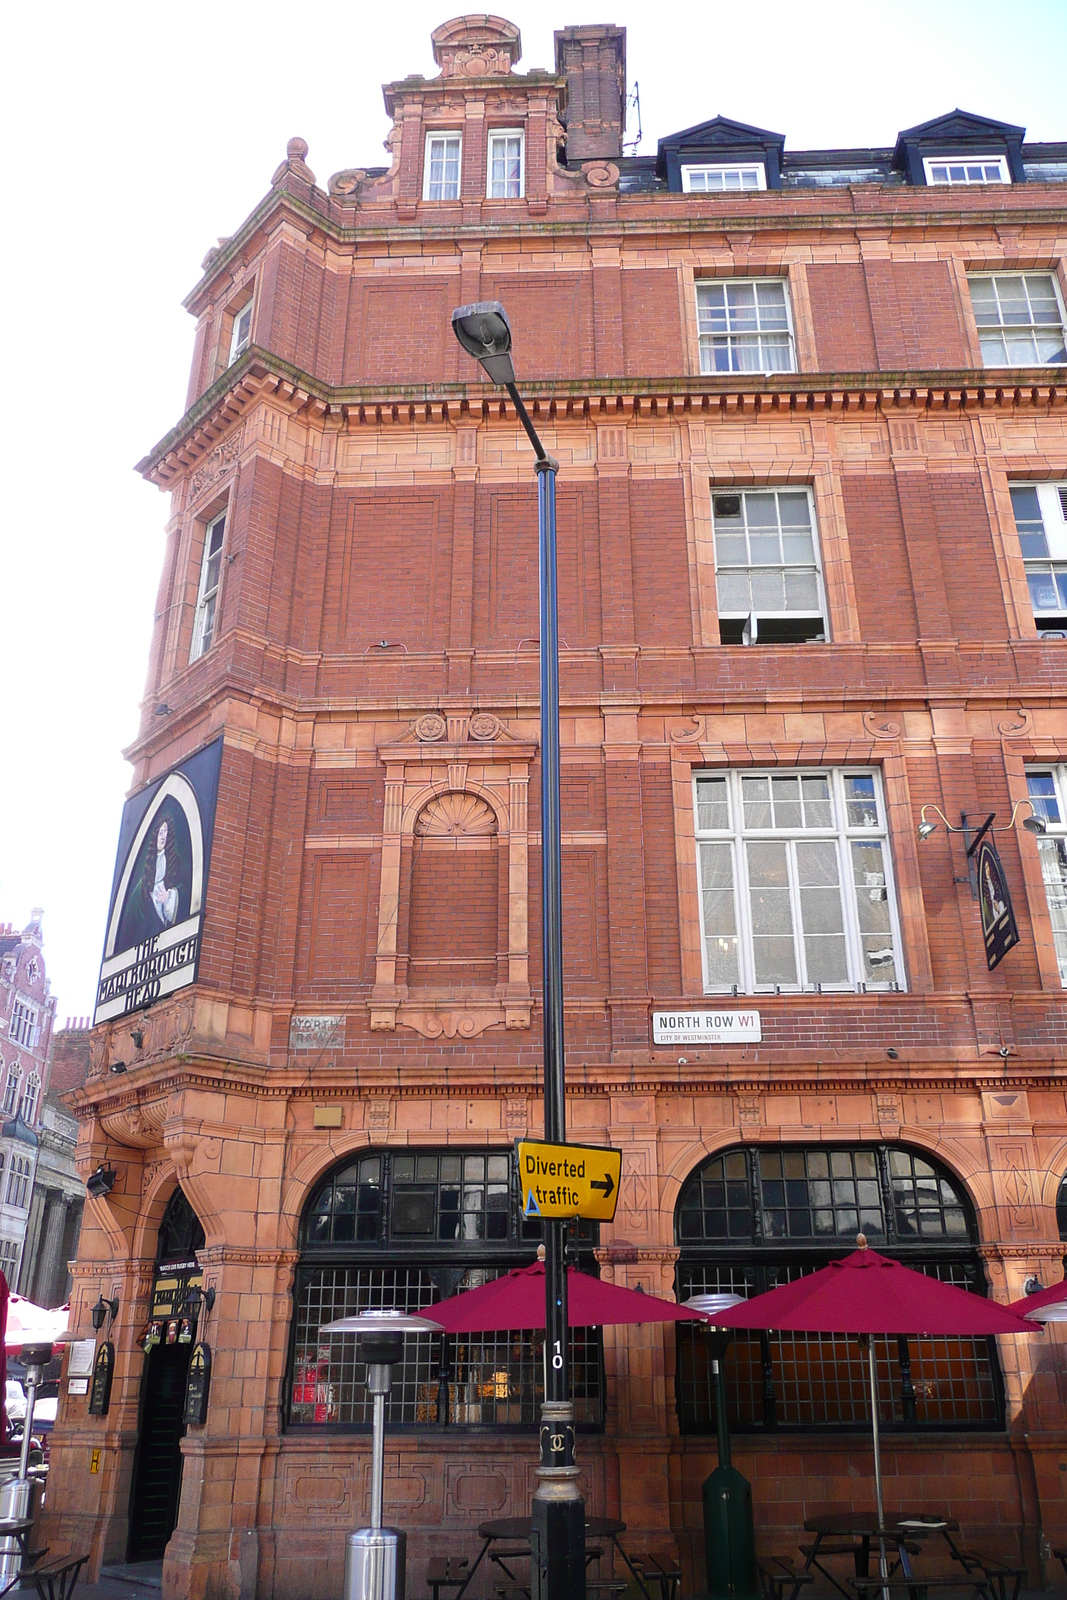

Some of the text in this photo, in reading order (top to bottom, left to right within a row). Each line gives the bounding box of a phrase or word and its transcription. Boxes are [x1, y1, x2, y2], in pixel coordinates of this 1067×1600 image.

[134, 934, 160, 961] THE
[98, 938, 198, 1001] MARLBOROUGH
[125, 979, 161, 1011] HEAD
[294, 1019, 338, 1030] NORTH
[659, 1015, 754, 1029] NORTH ROW W1
[525, 1155, 586, 1178] Diverted
[536, 1185, 579, 1206] traffic
